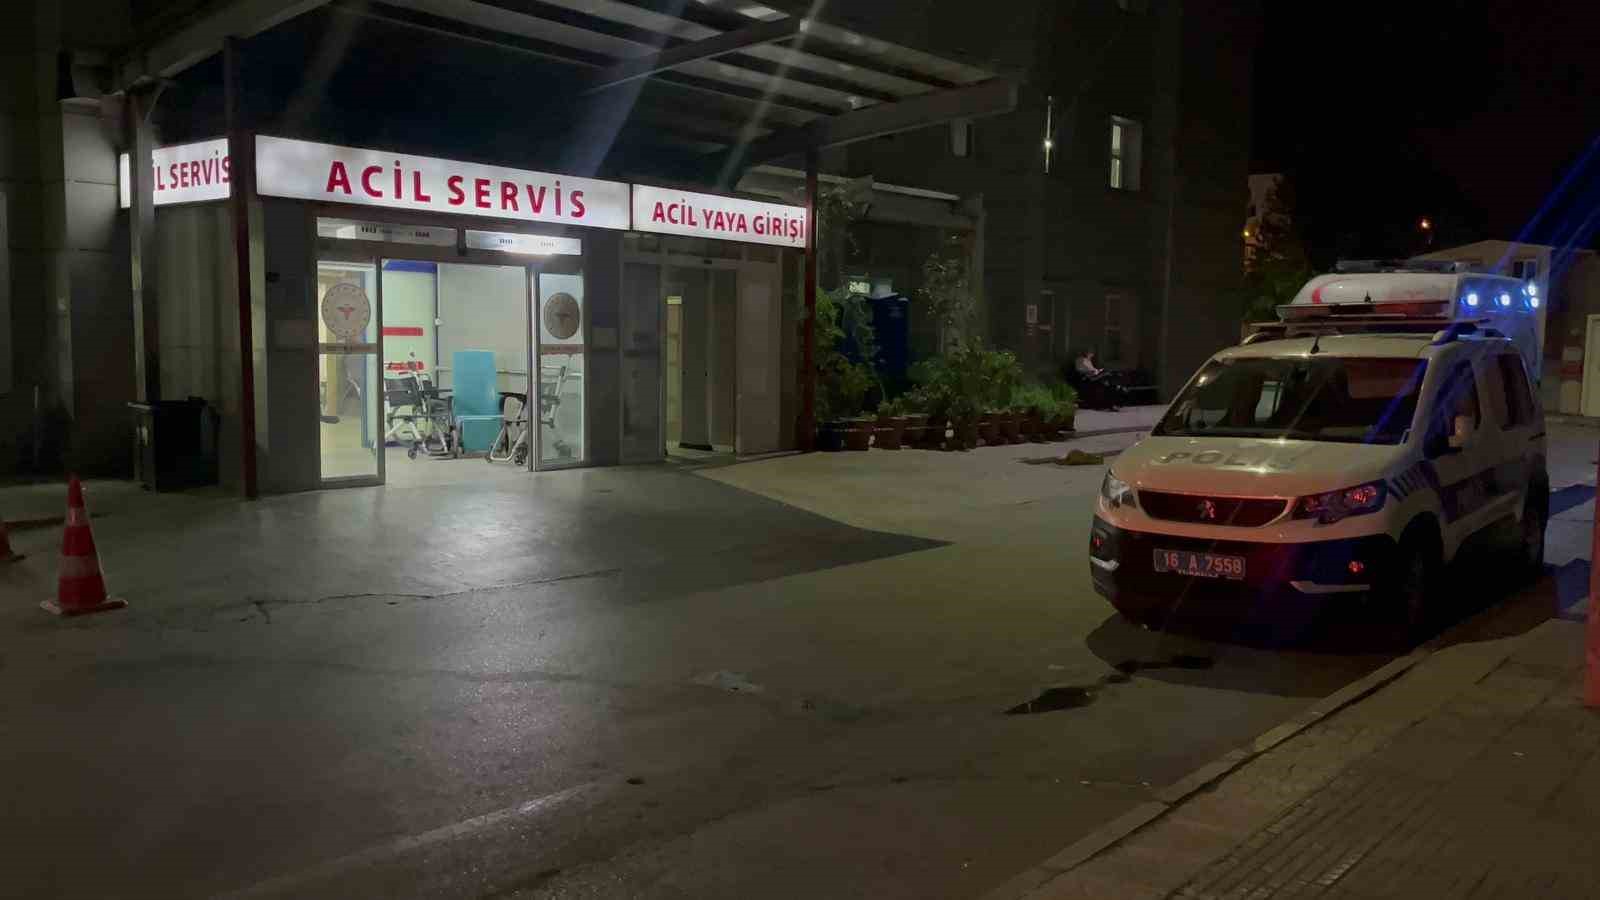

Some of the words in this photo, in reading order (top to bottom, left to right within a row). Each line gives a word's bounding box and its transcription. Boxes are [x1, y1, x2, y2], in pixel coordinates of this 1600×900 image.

[170, 149, 232, 189] SERVİS
[327, 160, 431, 202] ACİL
[448, 175, 586, 219] SERVİS
[652, 200, 697, 227] ACİL
[703, 209, 749, 234] YAYA
[753, 212, 805, 243] GİRİŞİ
[1164, 551, 1179, 569] 16
